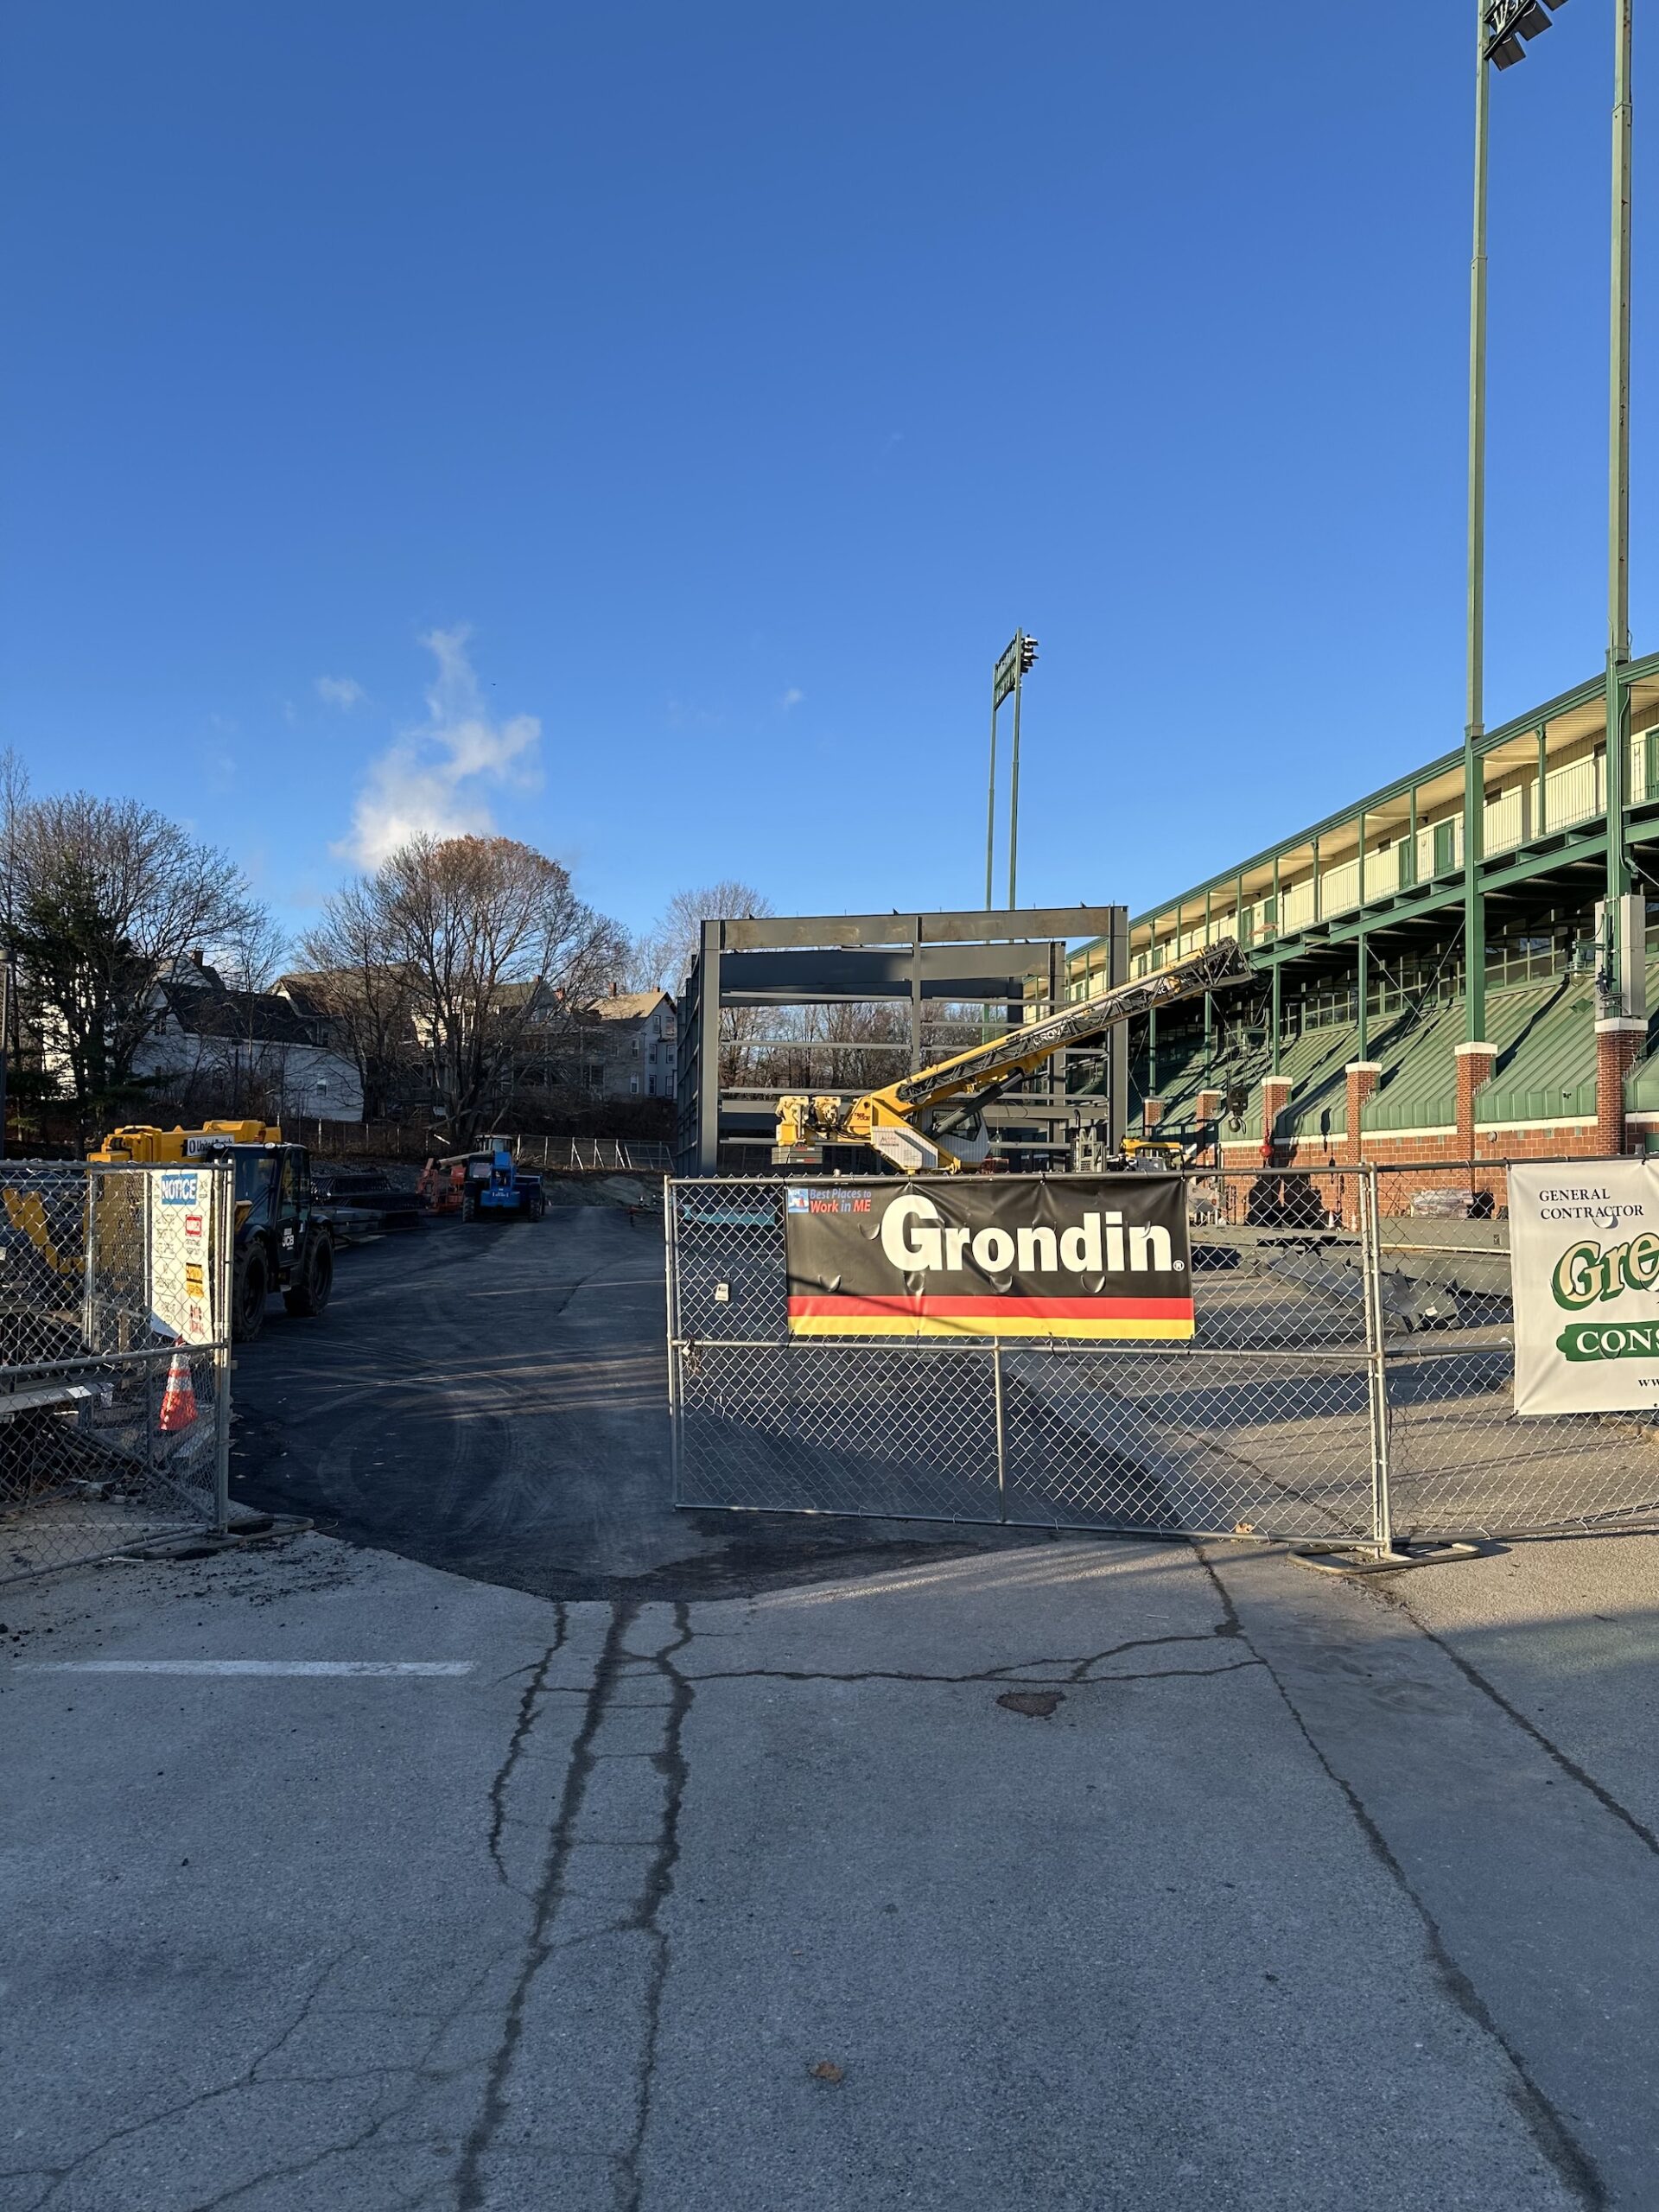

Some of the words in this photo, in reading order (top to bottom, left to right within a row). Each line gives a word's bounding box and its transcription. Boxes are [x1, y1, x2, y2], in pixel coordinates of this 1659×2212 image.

[162, 1179, 197, 1200] NOTICE
[810, 1188, 830, 1200] Best
[831, 1187, 862, 1199] Places
[863, 1189, 872, 1198] to
[1539, 1188, 1611, 1202] GENERAL
[810, 1199, 839, 1214] Work
[841, 1199, 852, 1212] in
[853, 1198, 872, 1212] ME
[1540, 1204, 1644, 1220] CONTRACTOR
[1552, 1231, 1659, 1312] Gre
[1576, 1328, 1659, 1354] CON
